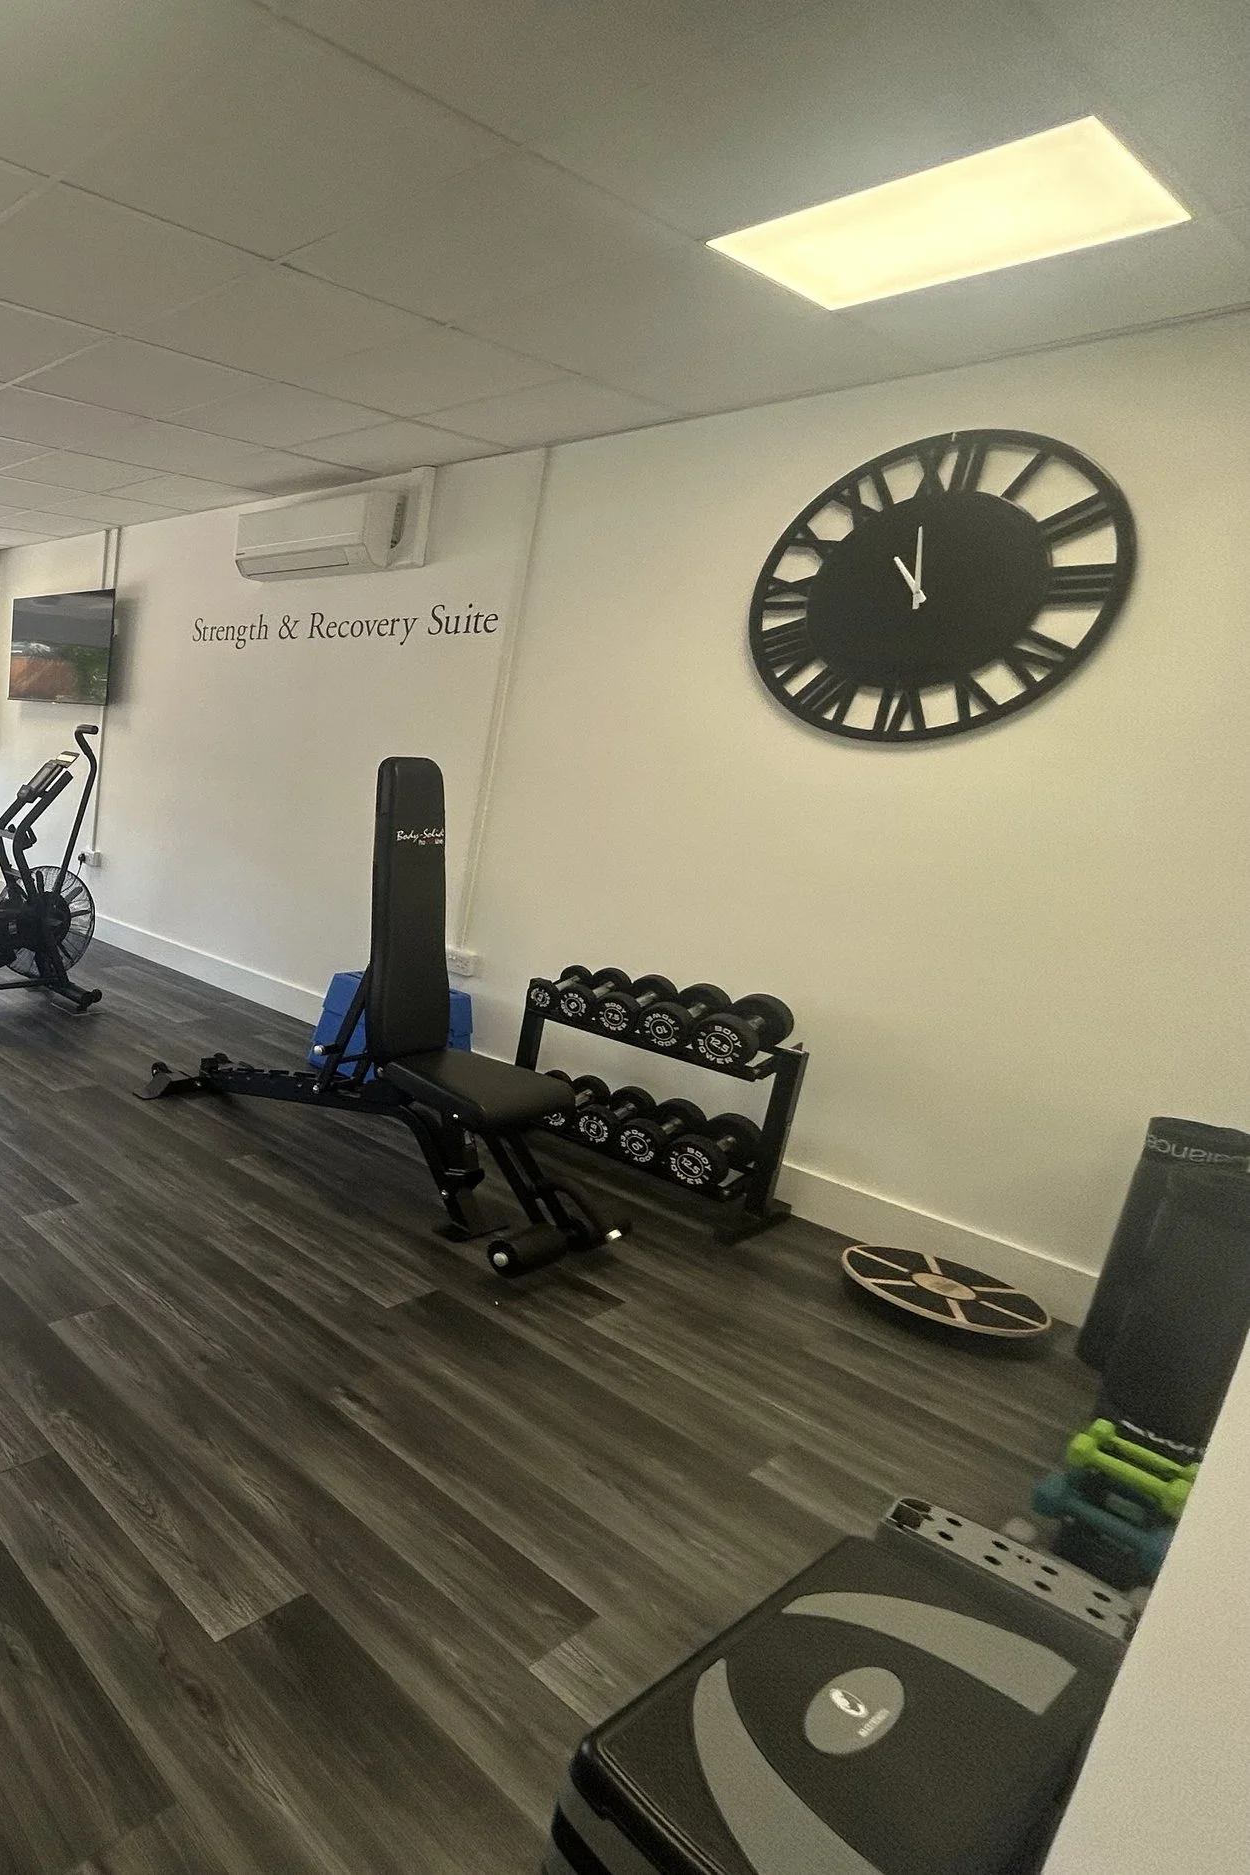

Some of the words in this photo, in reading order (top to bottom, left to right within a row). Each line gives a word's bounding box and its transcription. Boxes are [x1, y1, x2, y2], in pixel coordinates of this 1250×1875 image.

[192, 613, 269, 649] Strength
[278, 614, 300, 640] &
[307, 611, 419, 646] Recovery
[427, 603, 499, 635] Suite
[605, 1002, 627, 1013] BODY
[644, 1013, 675, 1028] POWER
[655, 1025, 668, 1034] 10
[651, 1038, 677, 1047] BODY
[710, 1036, 730, 1053] 12.5
[714, 1025, 742, 1048] BODY
[697, 1038, 734, 1064] POWER
[687, 1146, 712, 1171] BODY
[670, 1157, 704, 1185] POWER
